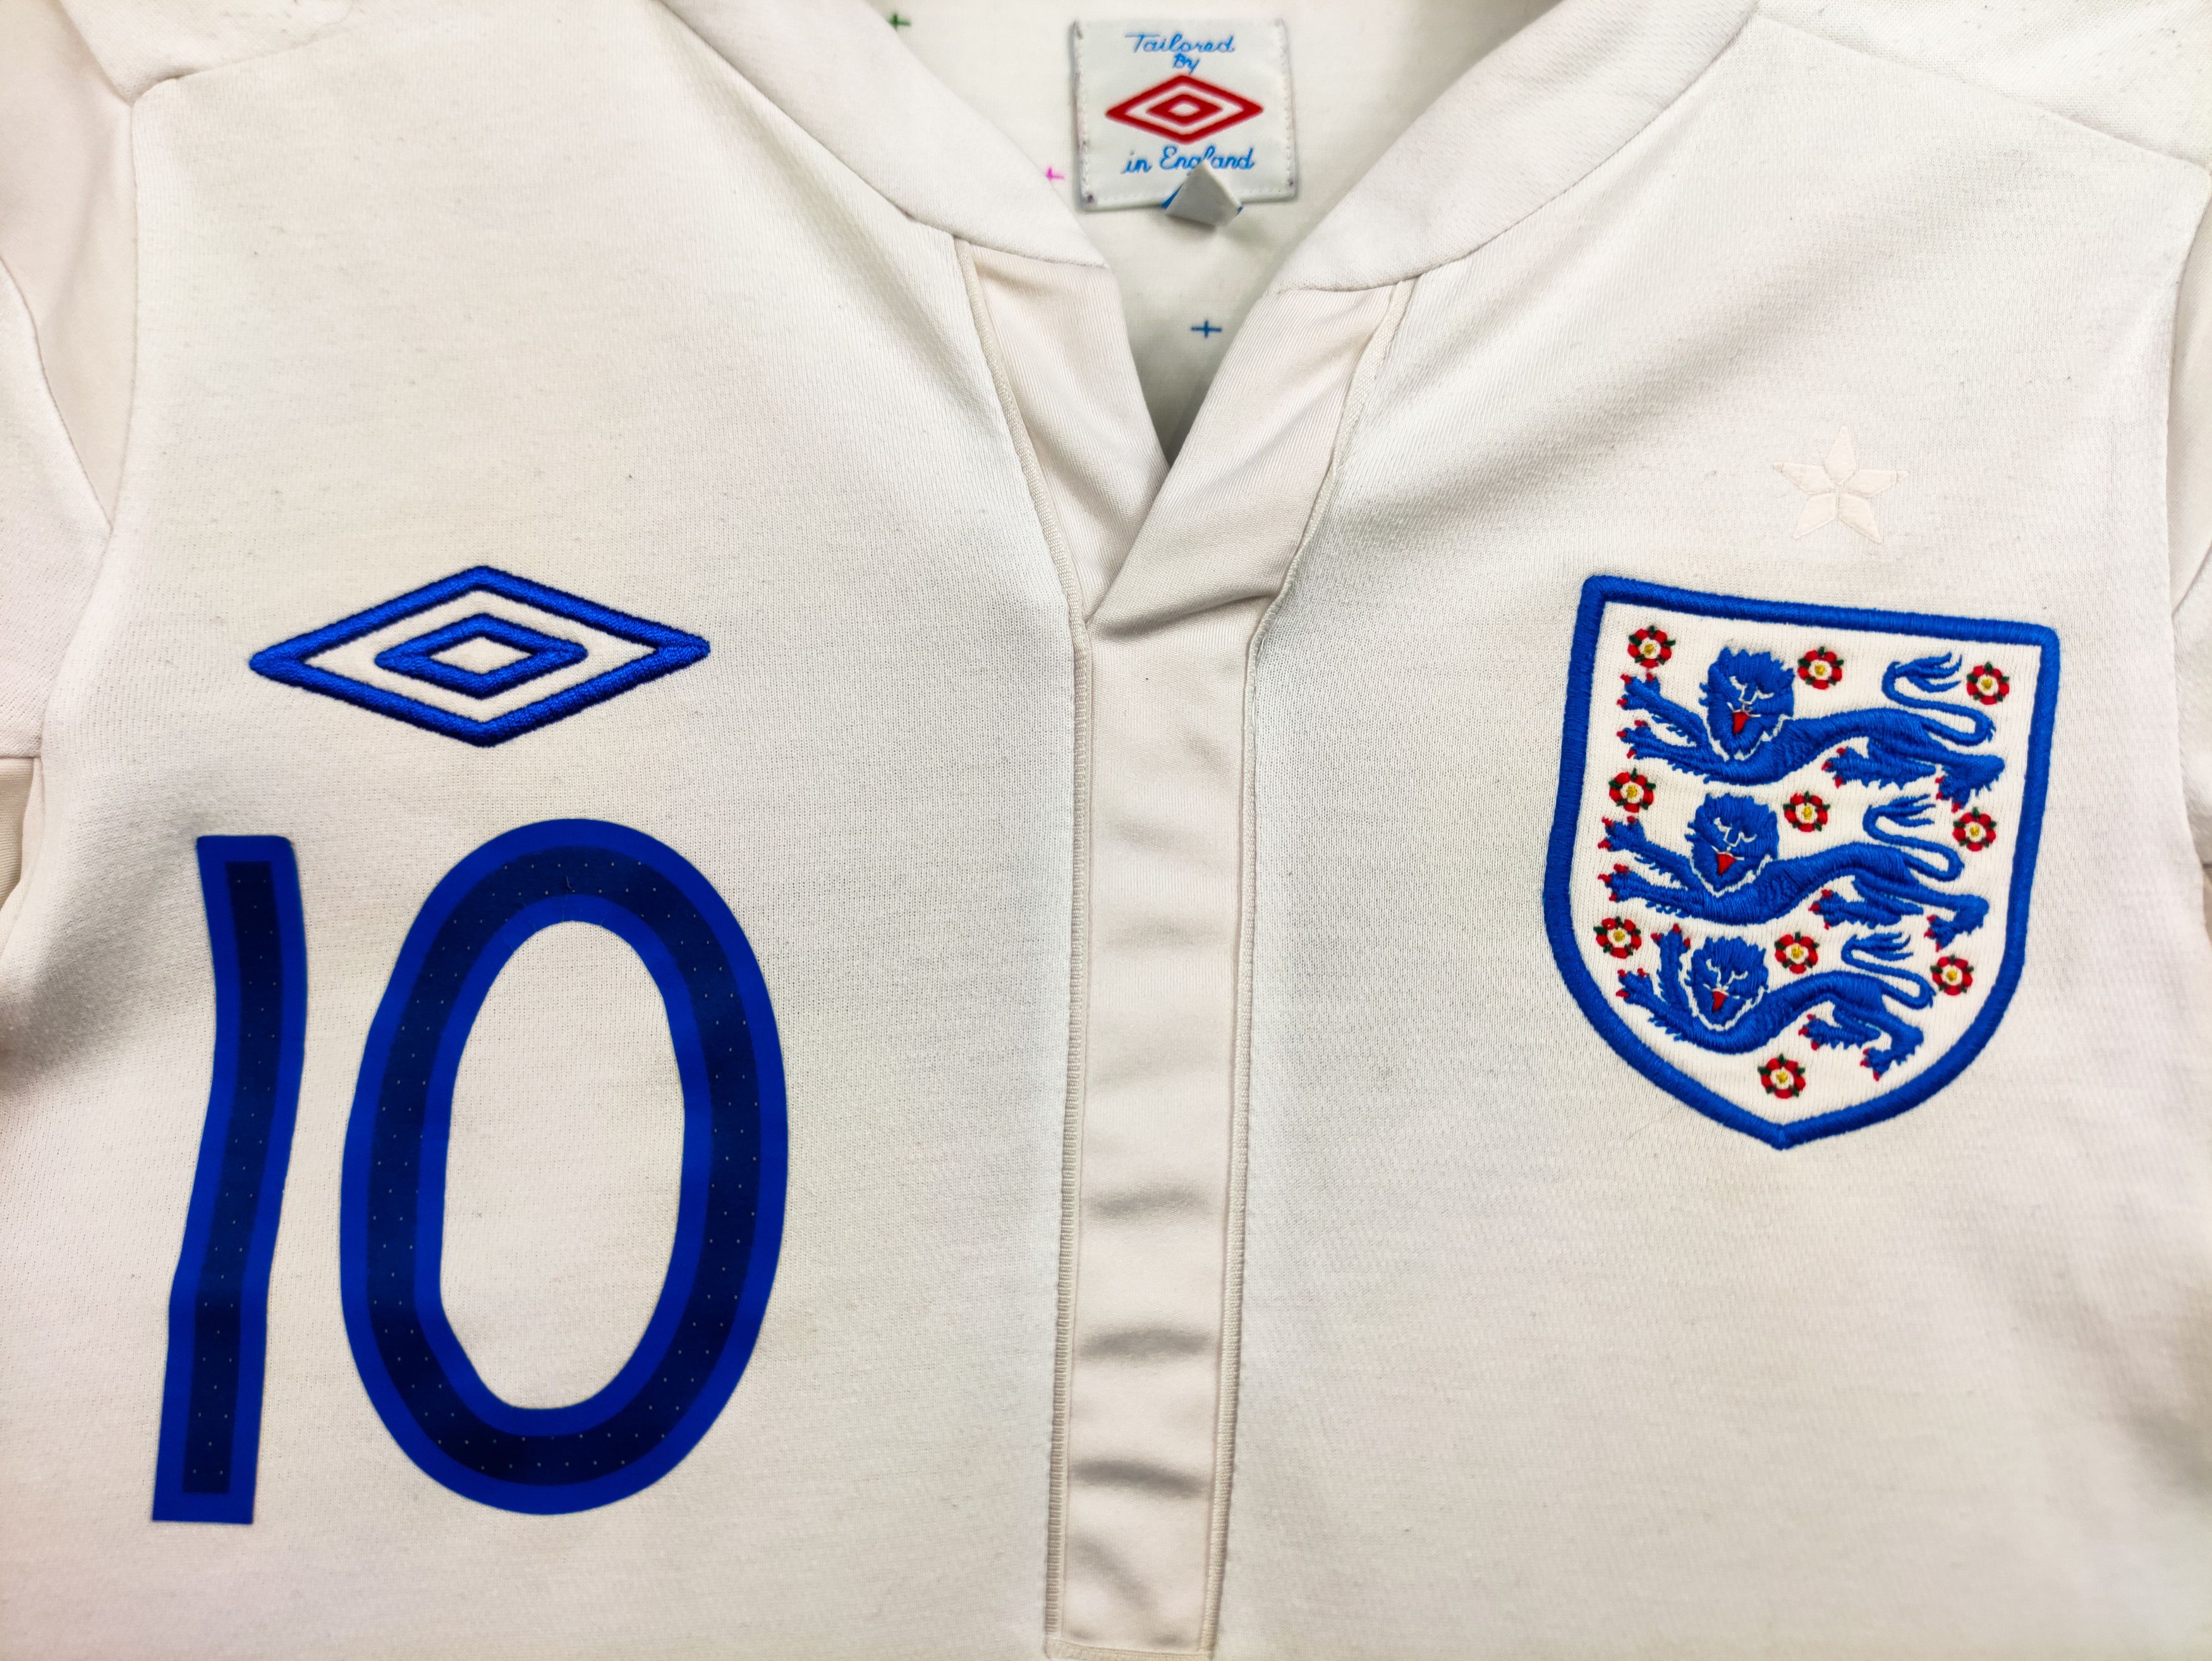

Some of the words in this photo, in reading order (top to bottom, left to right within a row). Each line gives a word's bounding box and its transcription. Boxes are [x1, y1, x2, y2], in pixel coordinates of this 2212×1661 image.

[1125, 33, 1235, 52] Tailored
[1121, 150, 1152, 174] in
[152, 818, 788, 1524] 10
